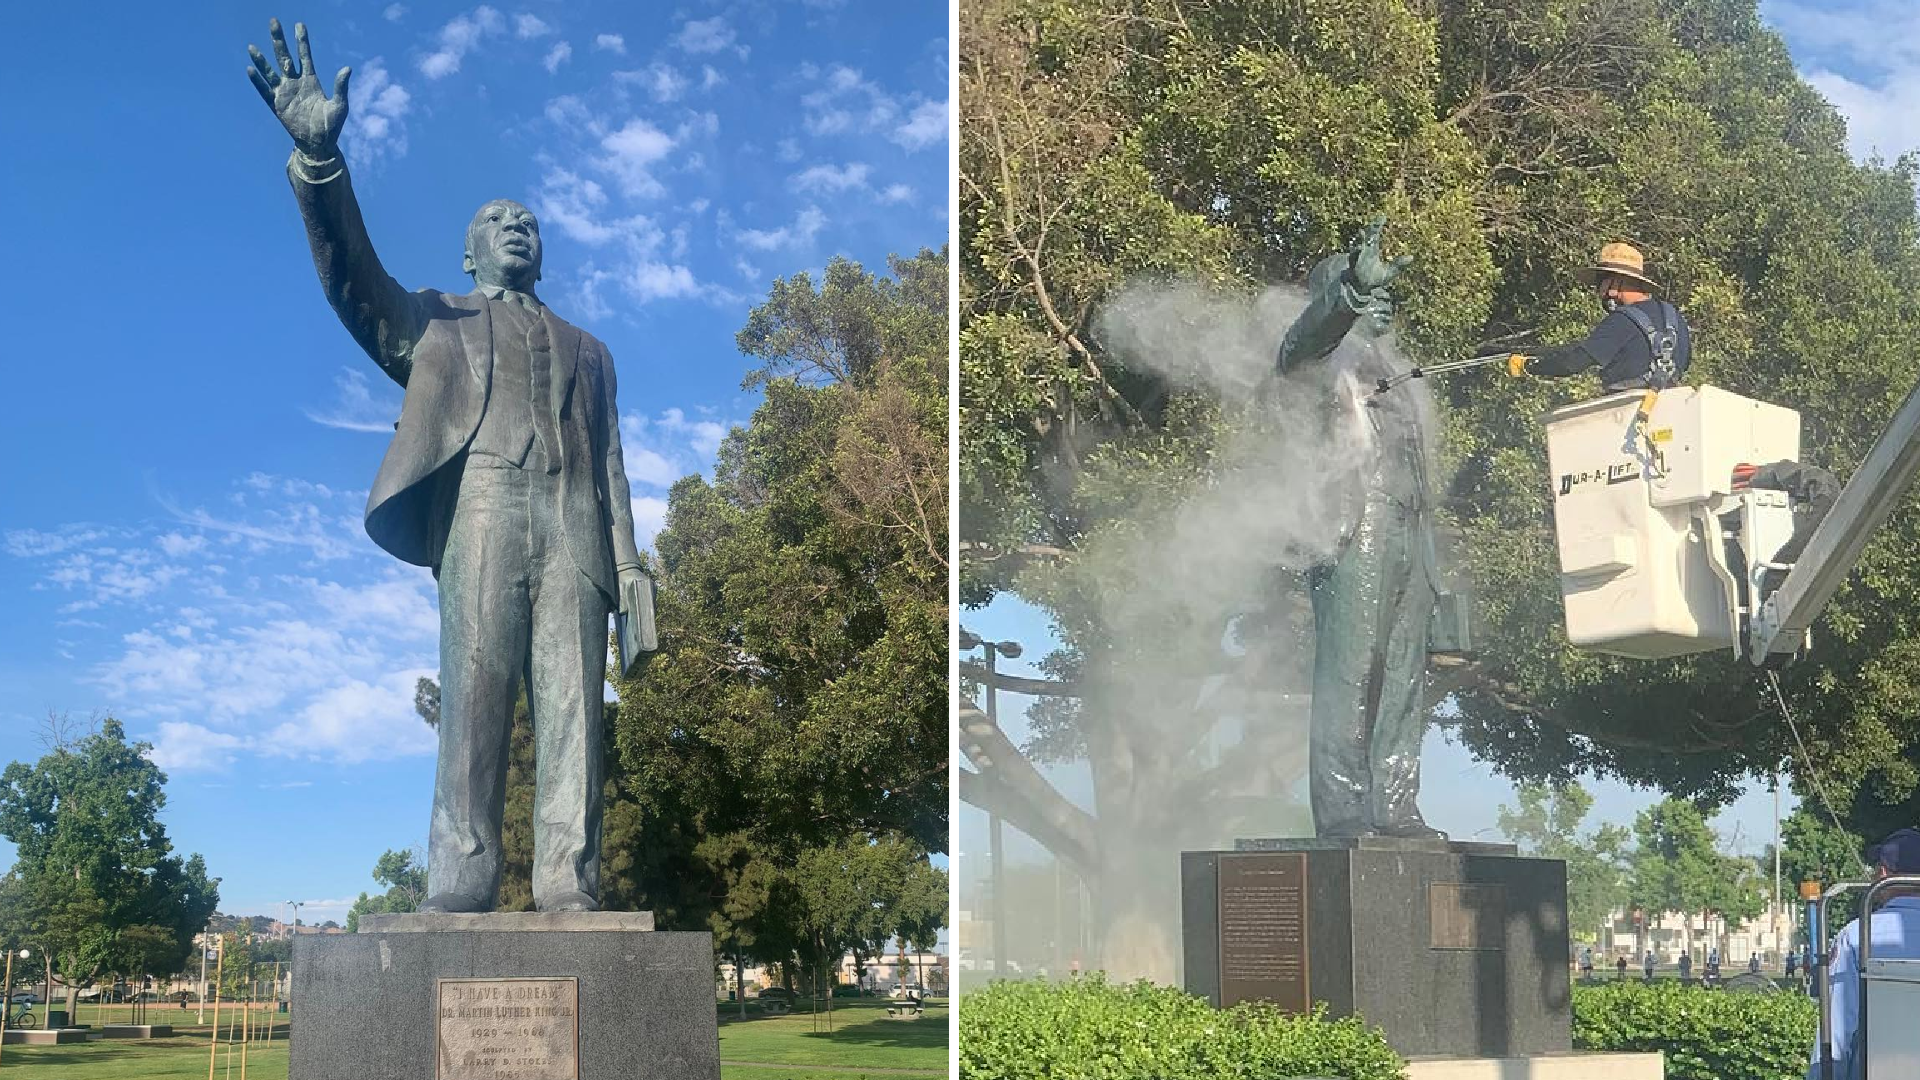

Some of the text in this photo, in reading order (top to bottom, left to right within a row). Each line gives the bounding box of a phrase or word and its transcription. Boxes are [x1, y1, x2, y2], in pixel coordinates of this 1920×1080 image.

[469, 987, 498, 999] HAVE
[505, 987, 514, 999] A
[459, 1007, 493, 1018] MARTIN
[496, 1006, 531, 1018] LUTHER
[534, 1006, 558, 1017] KING
[471, 1028, 498, 1038] 1929
[463, 1058, 496, 1066] LARRY
